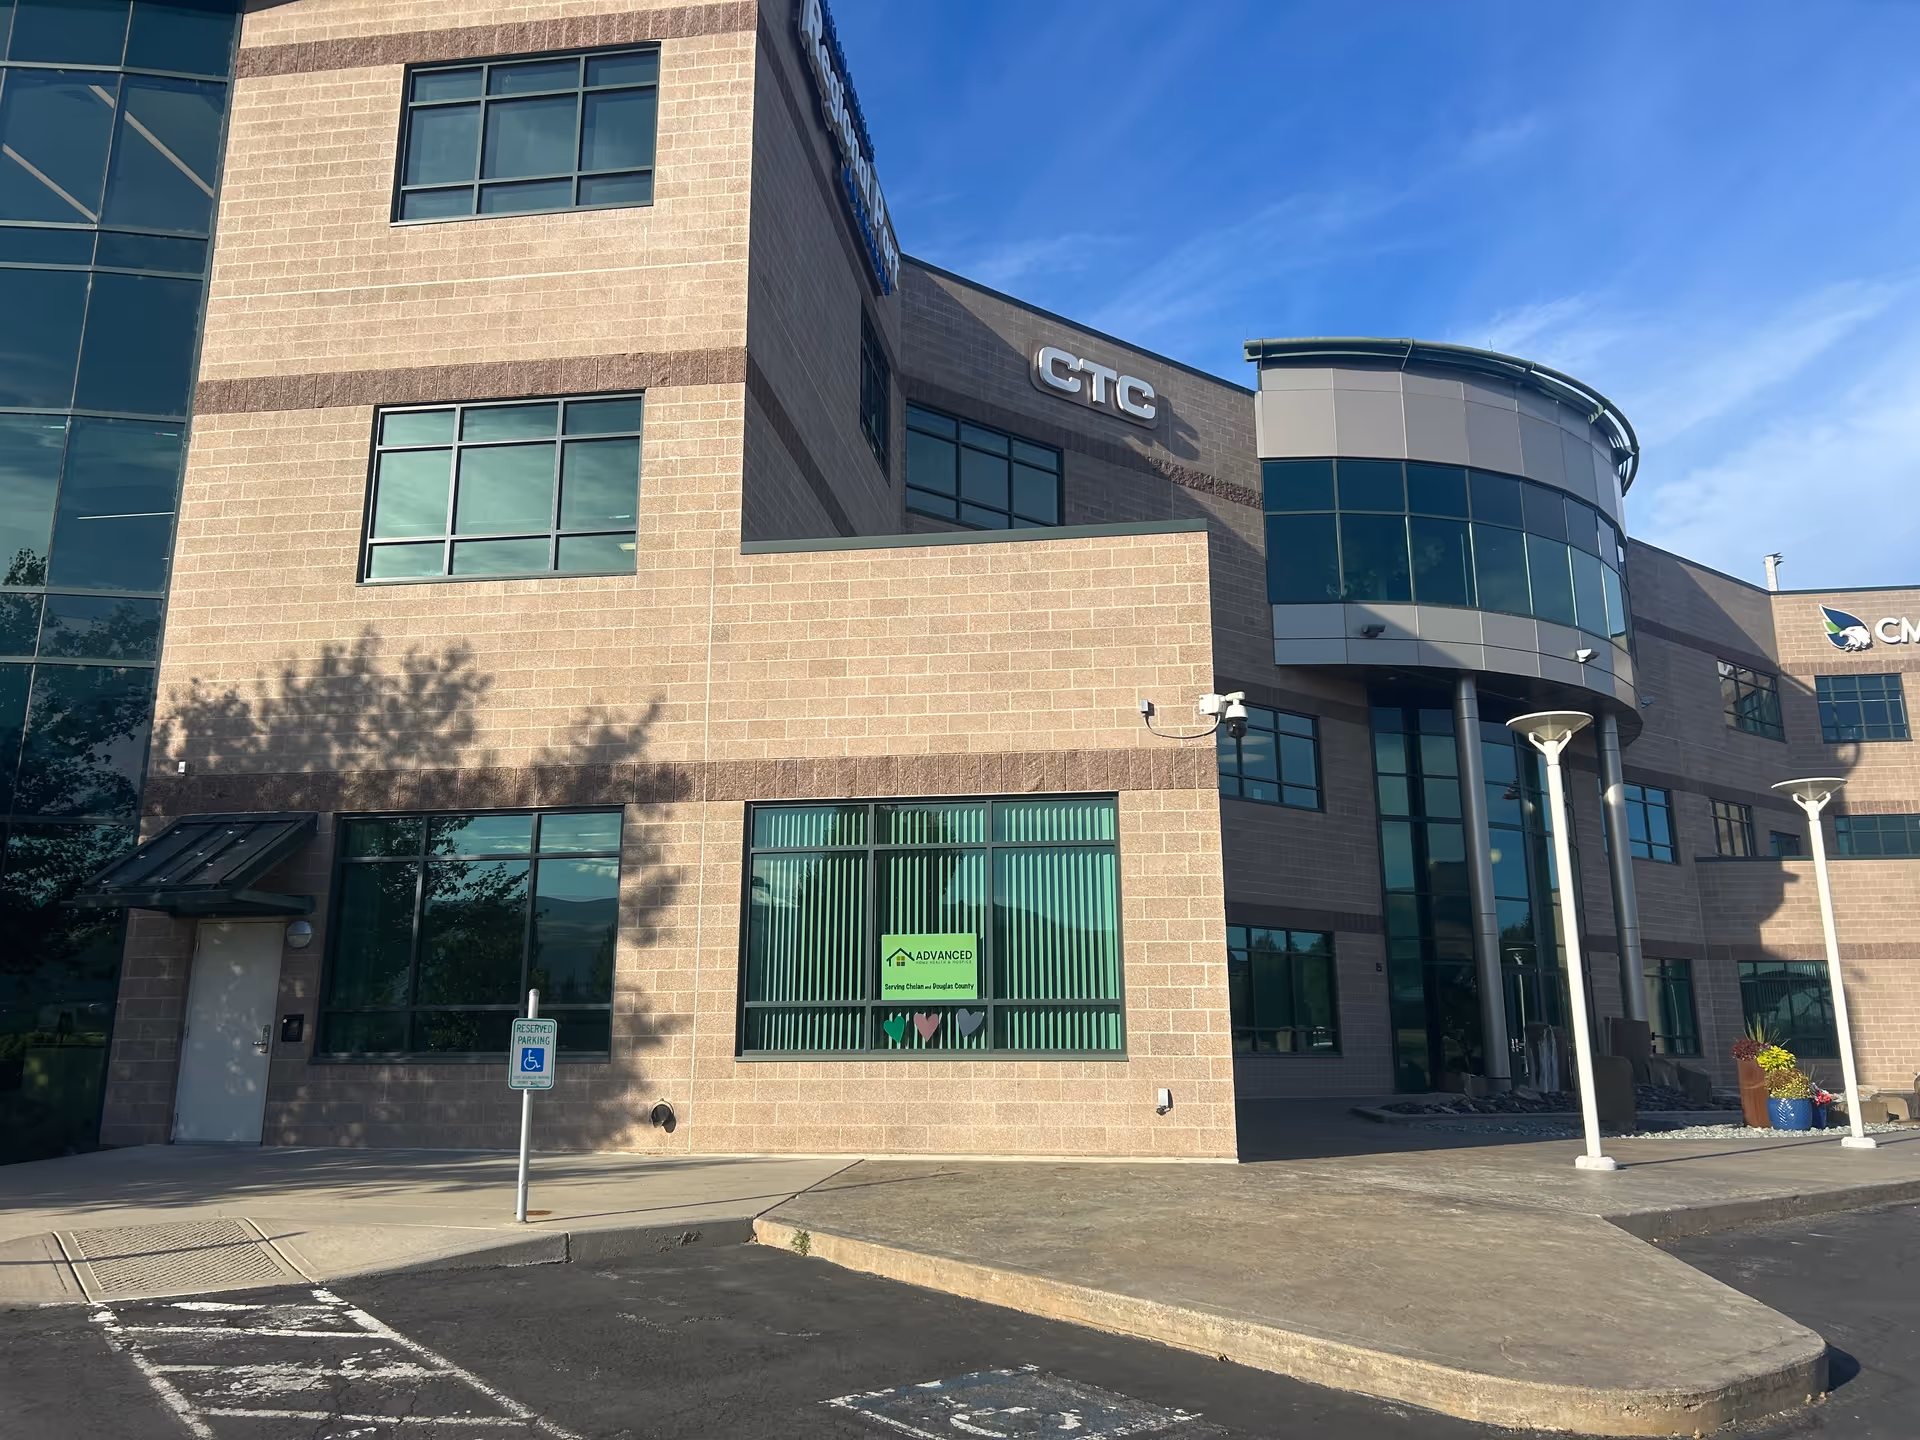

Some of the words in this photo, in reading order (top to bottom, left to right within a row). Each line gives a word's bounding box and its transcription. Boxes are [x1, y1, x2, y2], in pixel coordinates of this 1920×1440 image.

[801, 0, 873, 210] Regional
[869, 179, 899, 291] Port
[1038, 346, 1156, 420] CTC
[916, 950, 973, 960] ADVANCED
[885, 983, 904, 991] Serving
[933, 982, 953, 990] Douglas
[955, 982, 974, 990] County
[516, 1024, 553, 1034] RESERVED
[518, 1036, 550, 1045] PARKING
